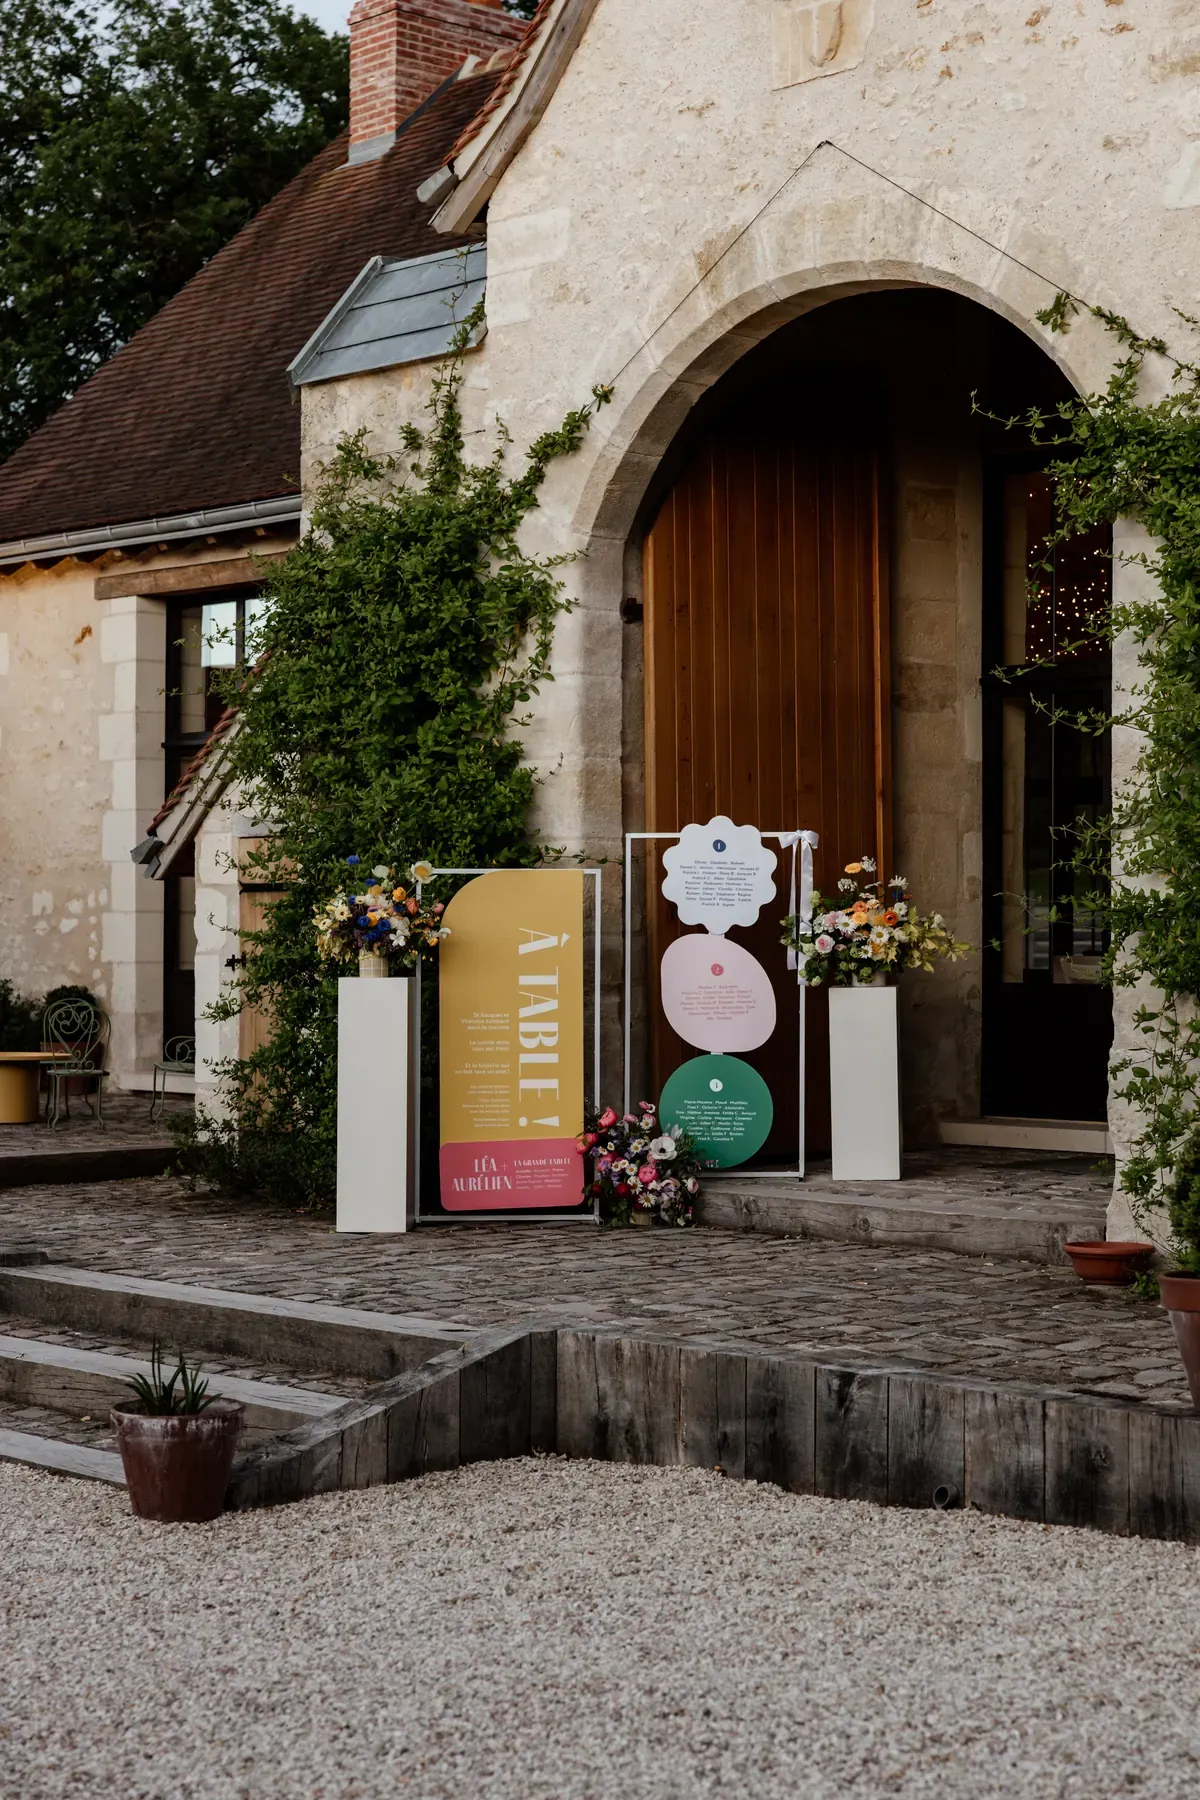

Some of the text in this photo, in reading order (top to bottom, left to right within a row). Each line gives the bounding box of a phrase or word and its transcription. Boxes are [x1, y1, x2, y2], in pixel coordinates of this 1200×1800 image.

[518, 966, 559, 1102] TABLE
[518, 1115, 560, 1127] !
[474, 1155, 497, 1172] LÉA
[452, 1174, 512, 1192] AURÉLIEN
